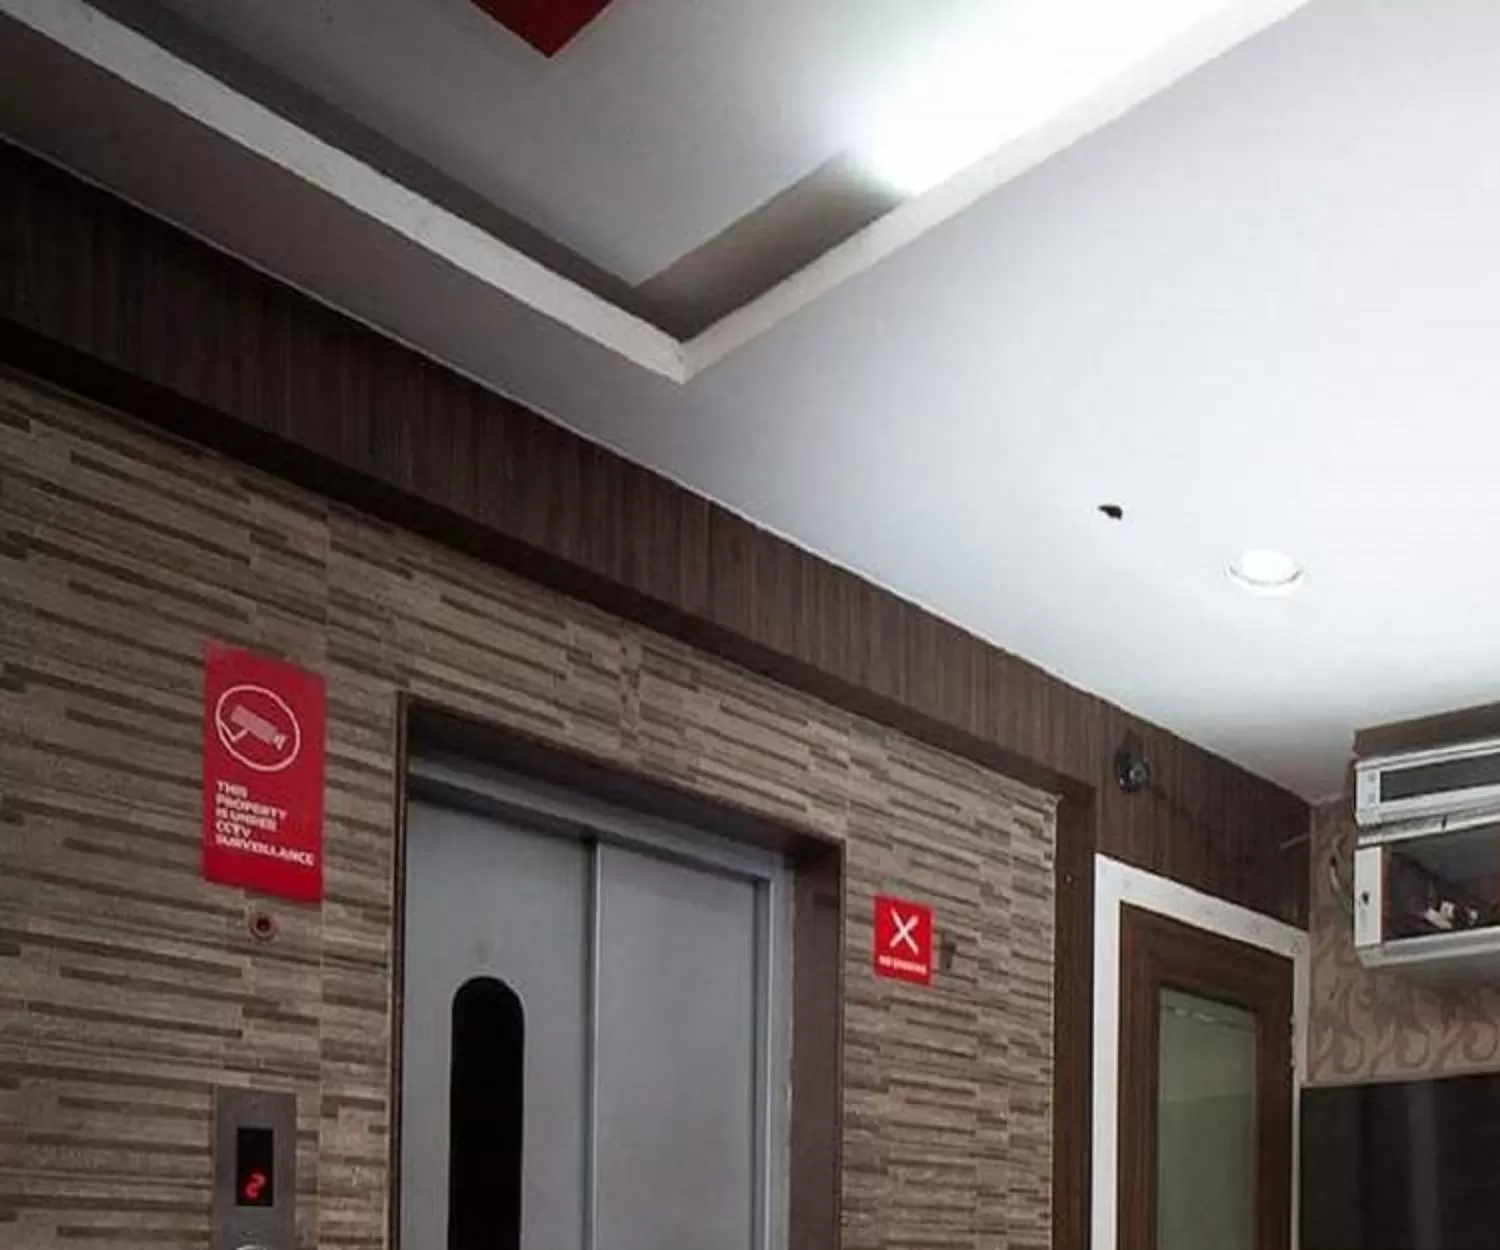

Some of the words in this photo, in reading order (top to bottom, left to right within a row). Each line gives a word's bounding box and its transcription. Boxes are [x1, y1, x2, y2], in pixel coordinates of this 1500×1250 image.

[217, 780, 248, 798] THIS
[216, 793, 287, 819] PROPERTY
[216, 820, 251, 838] CCTV
